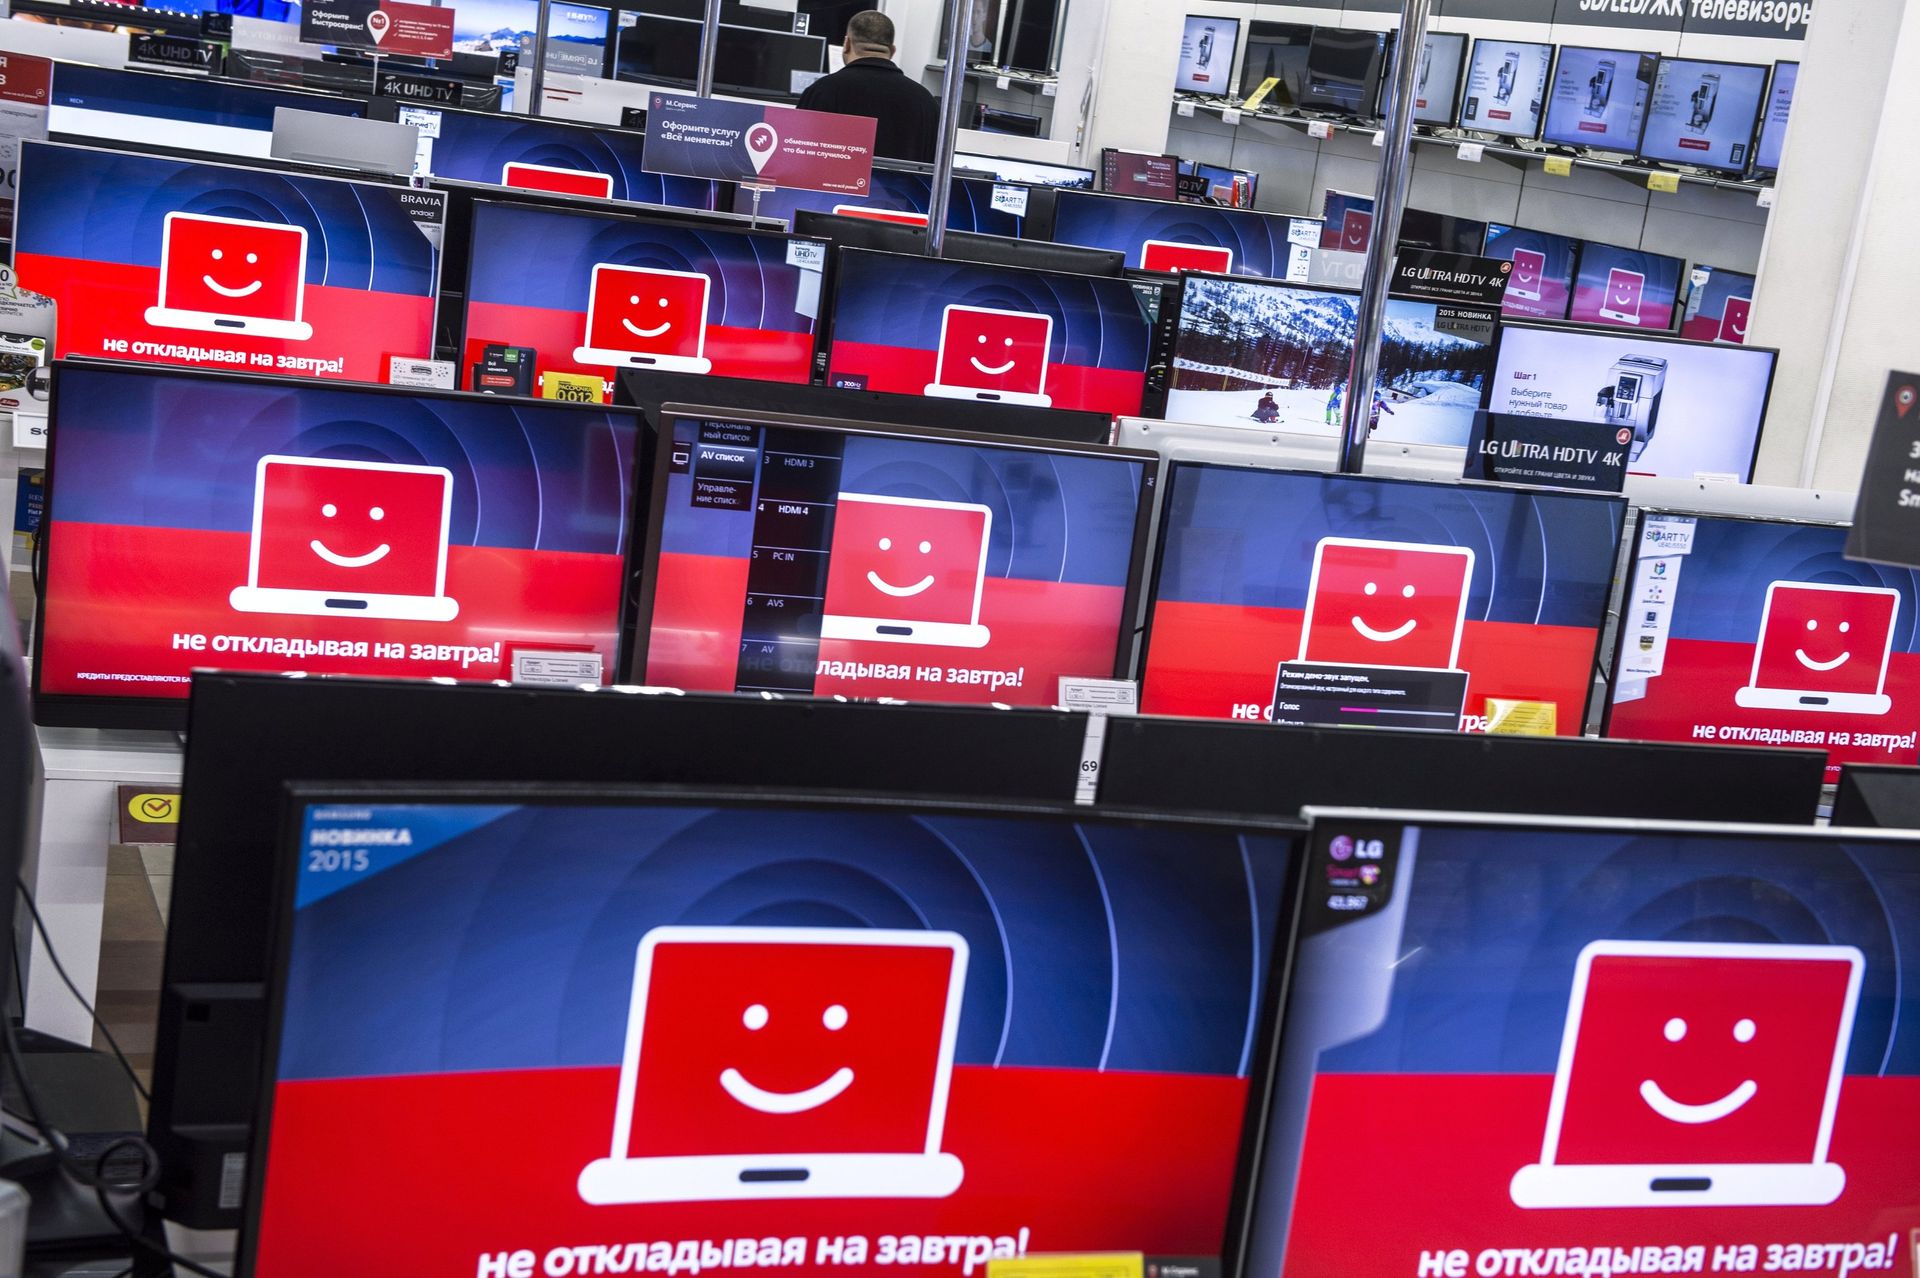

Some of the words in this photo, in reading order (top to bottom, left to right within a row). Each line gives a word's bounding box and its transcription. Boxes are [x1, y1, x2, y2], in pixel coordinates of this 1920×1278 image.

[312, 10, 350, 22] Оформите
[312, 18, 364, 31] Быстросервис!
[138, 43, 156, 55] 4K
[160, 46, 192, 60] UHD
[195, 48, 213, 63] TV
[384, 83, 401, 94] 4K
[404, 83, 434, 98] UHD
[436, 88, 454, 100] TV
[666, 100, 698, 110] М.Сервис
[662, 120, 710, 134] Оформите
[712, 127, 740, 138] услугу
[661, 132, 682, 142] «Всё
[684, 135, 734, 148] меняется»!
[784, 138, 818, 148] обменяем
[820, 142, 846, 150] технику
[847, 144, 868, 154] сразу,
[796, 148, 806, 156] бы
[816, 152, 852, 160] случилось
[400, 194, 442, 206] BRAVIA
[410, 208, 434, 218] android
[1402, 266, 1416, 276] LG
[1454, 274, 1487, 286] HDTV
[1489, 278, 1504, 288] 4K
[1439, 309, 1456, 317] 2015
[1458, 311, 1492, 320] НОВИНКА
[1470, 324, 1490, 333] HDTV
[103, 338, 128, 353] не
[132, 340, 246, 364] откладывая
[250, 352, 274, 366] на
[276, 354, 344, 376] завтра!
[1514, 372, 1532, 381] Шаг
[1511, 387, 1552, 400] Выберите
[1508, 400, 1542, 411] нужный
[1544, 402, 1568, 412] товар
[704, 432, 721, 440] ный
[701, 451, 714, 460] AV
[714, 453, 744, 463] список
[1478, 440, 1499, 455] LG
[1501, 440, 1550, 460] ULTRA
[1552, 446, 1598, 464] HDTV
[1602, 452, 1624, 467] 4K
[764, 456, 770, 464] 3
[784, 458, 808, 467] HDMI
[808, 460, 814, 468] 3
[1494, 466, 1522, 476] ОТКРОЙТЕ
[1535, 470, 1554, 478] ГРАНИ
[1554, 472, 1572, 480] ЦВЕТА
[1578, 474, 1596, 482] ЗВУКА
[697, 482, 737, 494] Управле-
[758, 504, 764, 512] 4
[778, 505, 802, 514] HDMI
[802, 506, 808, 515] 4
[1646, 530, 1678, 543] SMART
[1679, 534, 1690, 543] TV
[753, 550, 758, 558] 5
[772, 552, 784, 560] PC
[747, 598, 752, 606] 6
[766, 599, 784, 608] AVS
[172, 634, 206, 650] не
[212, 635, 368, 658] откладывая
[374, 642, 405, 659] на
[410, 642, 500, 668] завтра!
[742, 644, 748, 652] 7
[761, 645, 774, 654] AV
[77, 672, 110, 680] КРЕДИТЫ
[111, 673, 181, 683] ПРЕДОСТАВЛЯЮТСЯ
[916, 667, 942, 682] на
[946, 667, 1024, 692] завтра!
[1282, 670, 1304, 679] Режим
[1232, 703, 1260, 719] не
[1280, 702, 1300, 710] Голос
[1692, 724, 1716, 738] не
[1719, 725, 1826, 744] откладывая
[1828, 731, 1850, 745] на
[1852, 730, 1916, 752] завтра!
[1082, 760, 1098, 772] 69
[310, 828, 412, 846] НОВИНКА
[1355, 839, 1384, 858] LG
[308, 849, 370, 872] 2015
[477, 1249, 536, 1278] не
[544, 1236, 807, 1277] откладывая
[815, 1235, 868, 1265] на
[874, 1226, 1030, 1277] завтра!
[1418, 1248, 1470, 1278] не
[1476, 1244, 1706, 1278] откладывая
[1712, 1244, 1759, 1272] на
[1763, 1232, 1898, 1278] завтра!
